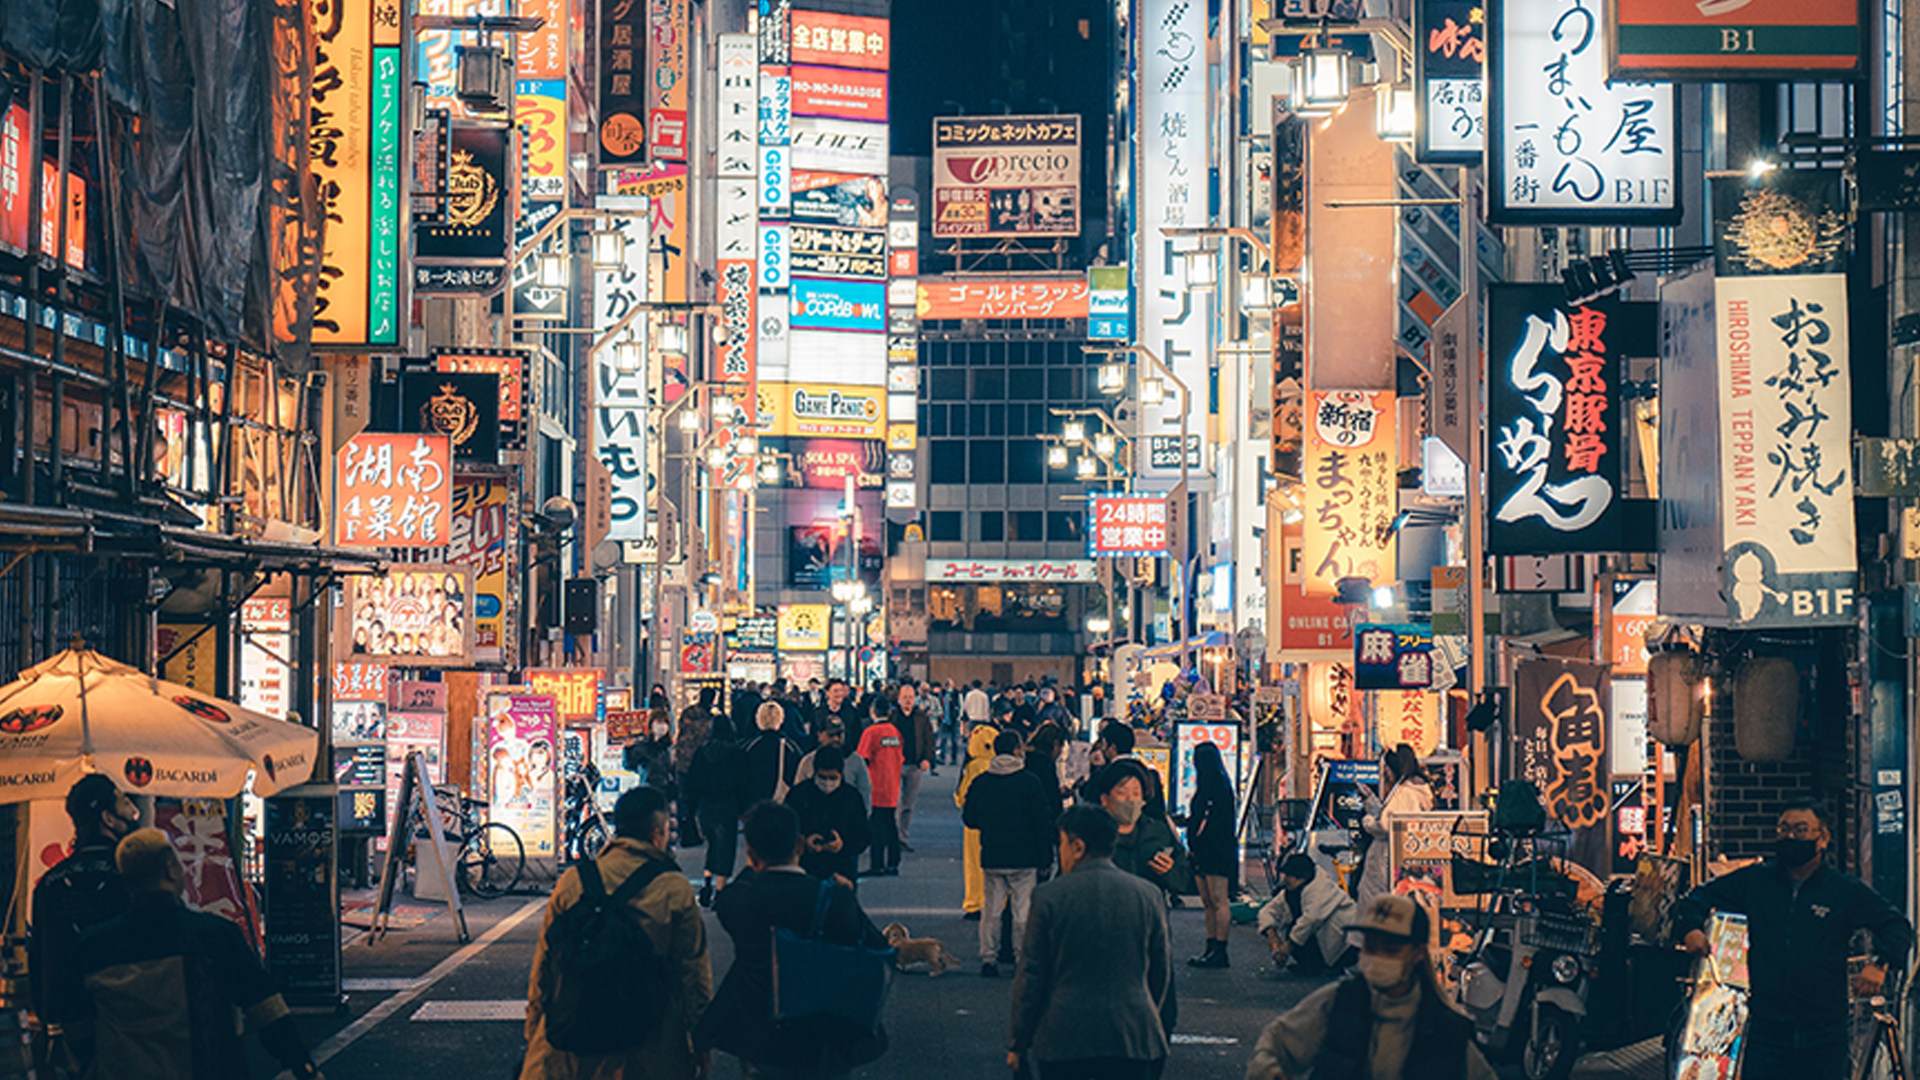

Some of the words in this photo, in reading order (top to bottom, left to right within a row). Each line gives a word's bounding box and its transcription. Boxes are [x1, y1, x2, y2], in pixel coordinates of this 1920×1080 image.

[792, 23, 884, 57] 全店営業中
[1720, 29, 1756, 52] B1
[792, 81, 883, 98] MO-MO-PARADISE
[1543, 0, 1605, 203] うまいもん
[775, 78, 790, 136] カラオケ
[1600, 80, 1663, 155] 屋
[938, 124, 1076, 142] コミック&ネットカフェ
[1406, 169, 1422, 183] 4
[1512, 123, 1541, 203] 一番街
[1614, 179, 1669, 204] B1F
[979, 301, 1054, 316] ハンバーグ
[1402, 324, 1427, 350] B1
[1728, 300, 1752, 399] HIROSHIMA
[598, 217, 641, 522] とんかにいむら
[795, 390, 828, 415] GAME
[831, 392, 864, 416] PANIC
[1563, 305, 1607, 474] 東京豚骨
[1319, 402, 1373, 432] 新宿
[1763, 297, 1846, 546] お好み焼き
[1336, 430, 1358, 445] の
[345, 436, 444, 493] 湖南
[806, 451, 834, 465] SOLA
[343, 495, 364, 541] 4F
[365, 494, 443, 543] 菜館
[1101, 502, 1166, 524] 24時間
[1315, 450, 1357, 578] まっちゃん
[1101, 526, 1165, 547] 営業中
[456, 547, 504, 580] フェ
[943, 563, 998, 578] コーヒー
[1038, 562, 1079, 579] クール
[1792, 588, 1854, 617] B1F
[1288, 616, 1328, 629] ONLINE
[1317, 633, 1333, 646] B1
[1398, 635, 1432, 647] フリー
[532, 674, 594, 714] 案内所
[271, 831, 333, 845] VAMOS
